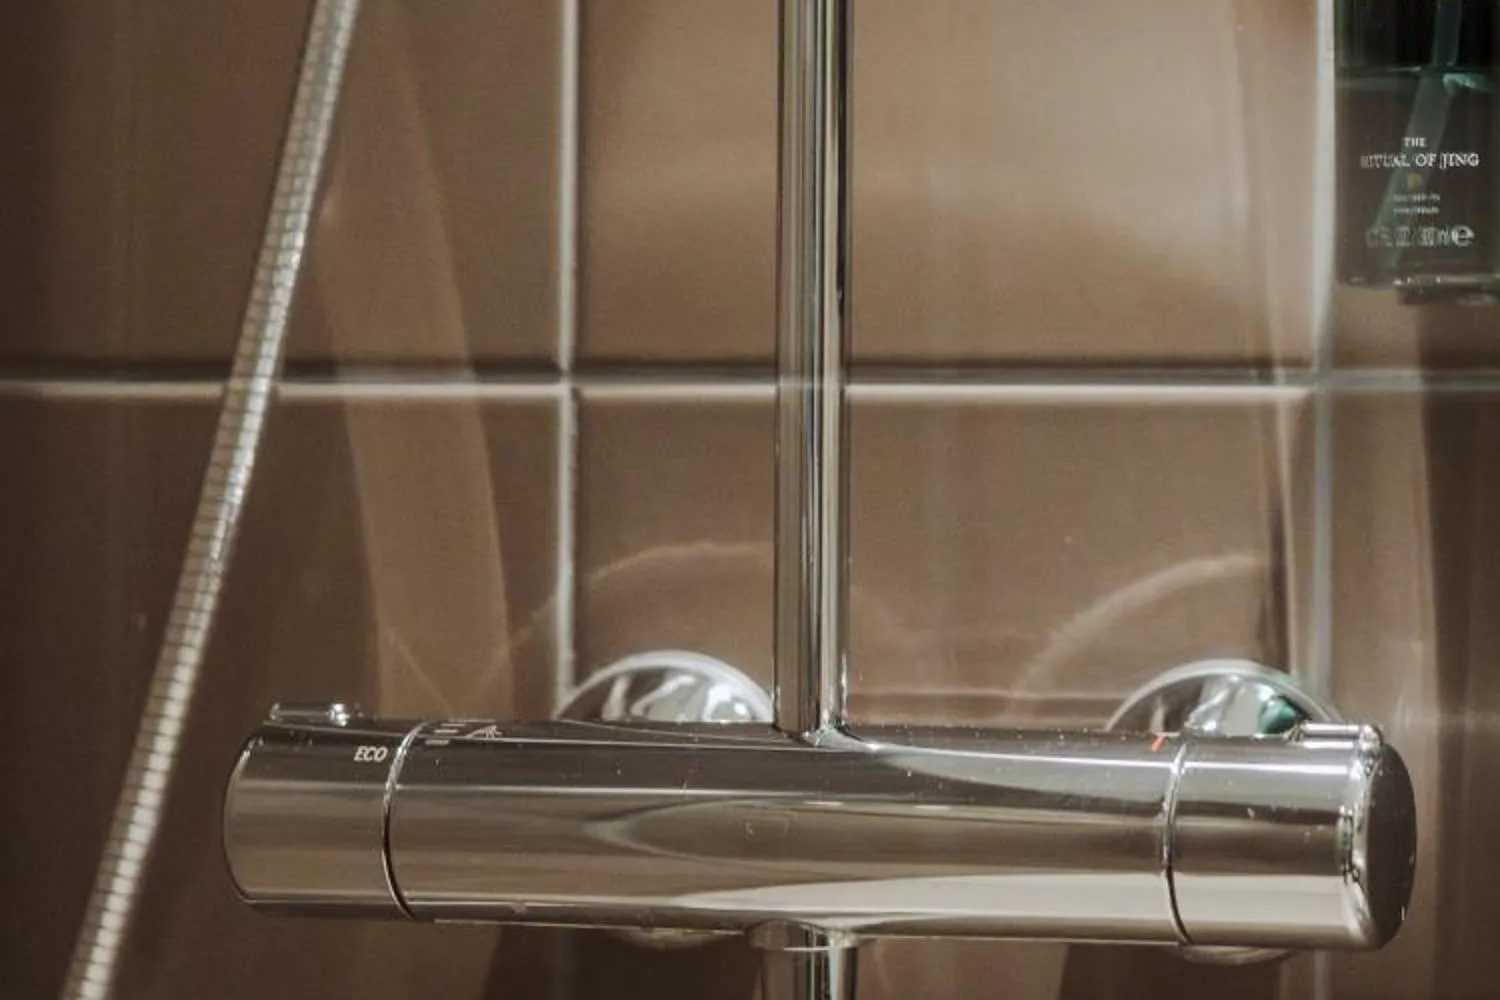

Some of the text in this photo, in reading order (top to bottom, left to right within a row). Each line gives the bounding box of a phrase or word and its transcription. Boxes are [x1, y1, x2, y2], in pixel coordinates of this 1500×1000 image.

[1403, 136, 1428, 148] THE
[1415, 152, 1438, 168] OF
[1439, 151, 1480, 170] JING
[353, 745, 389, 763] ECO
